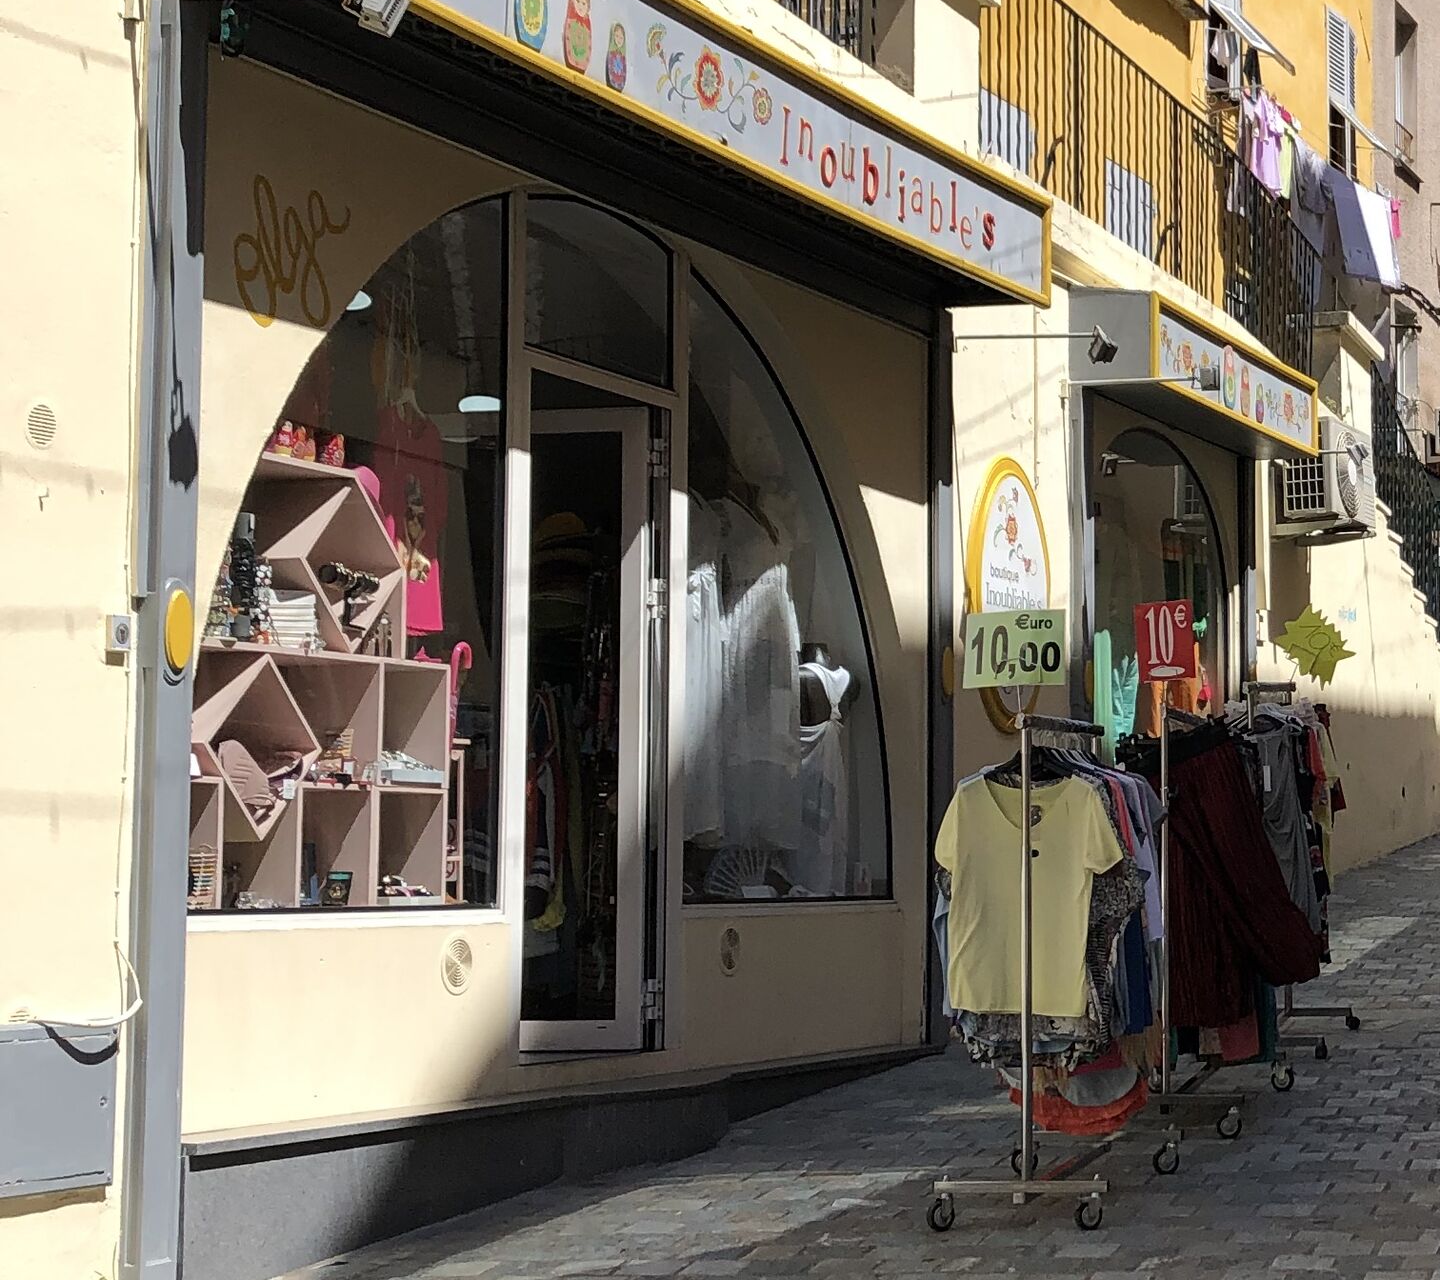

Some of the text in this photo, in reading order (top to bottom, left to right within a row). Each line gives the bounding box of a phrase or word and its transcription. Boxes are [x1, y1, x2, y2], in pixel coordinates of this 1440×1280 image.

[779, 106, 997, 252] Inoubliable's
[989, 562, 1020, 584] boutique
[972, 625, 1061, 680] 10,00
